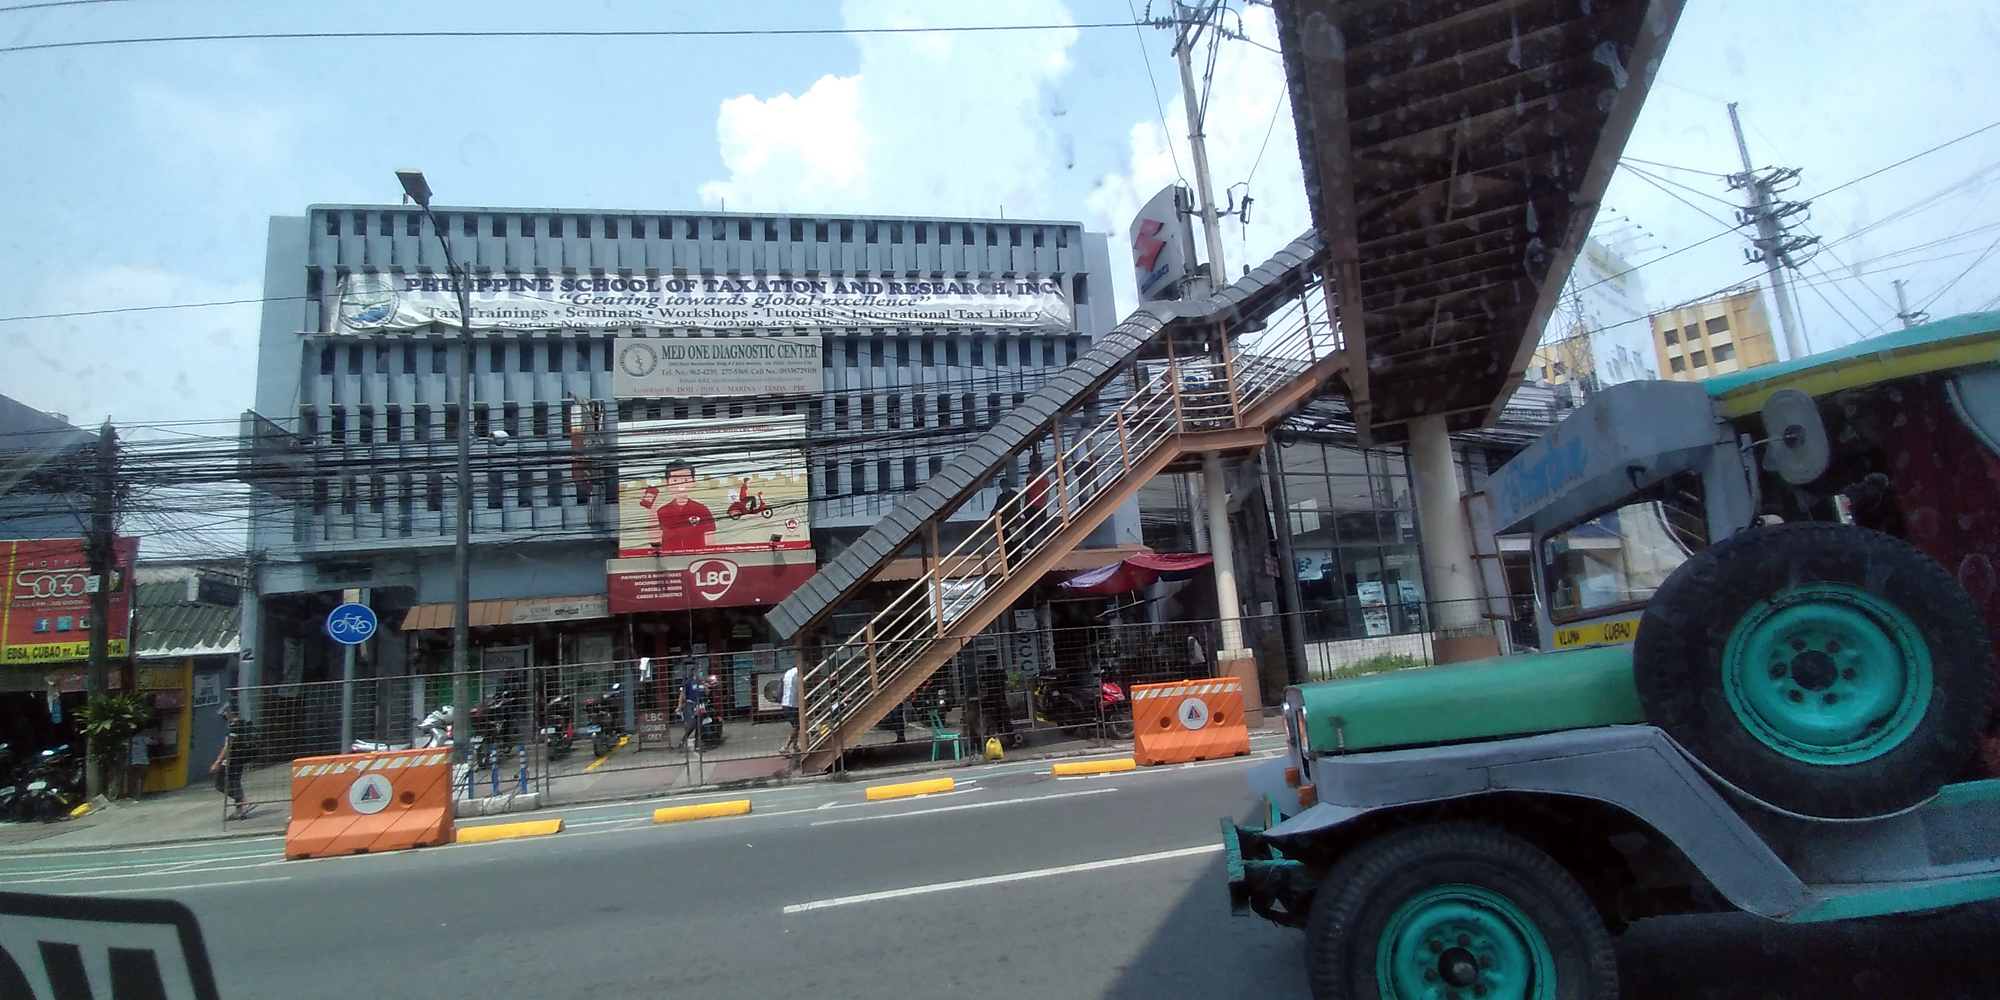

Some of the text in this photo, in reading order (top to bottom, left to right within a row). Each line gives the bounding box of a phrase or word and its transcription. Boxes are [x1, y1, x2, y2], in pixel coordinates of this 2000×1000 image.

[560, 278, 661, 293] SCHOOL
[666, 279, 698, 293] OF
[703, 279, 827, 293] TAXATION
[833, 280, 883, 295] AND
[888, 281, 1012, 297] RESEARCH,
[666, 293, 748, 306] towards
[752, 293, 815, 308] global
[426, 306, 1041, 320] Tax Trainings Seminars Workshops Tutorials International Tax Library
[662, 344, 817, 360] MED ONE DIAGNOSTIC CENTER
[28, 559, 80, 568] HOTEL
[14, 567, 92, 600] SOGO
[695, 570, 732, 587] LBC
[1604, 622, 1630, 641] CUBAO
[33, 646, 61, 660] CUBAO
[645, 713, 664, 722] LBC
